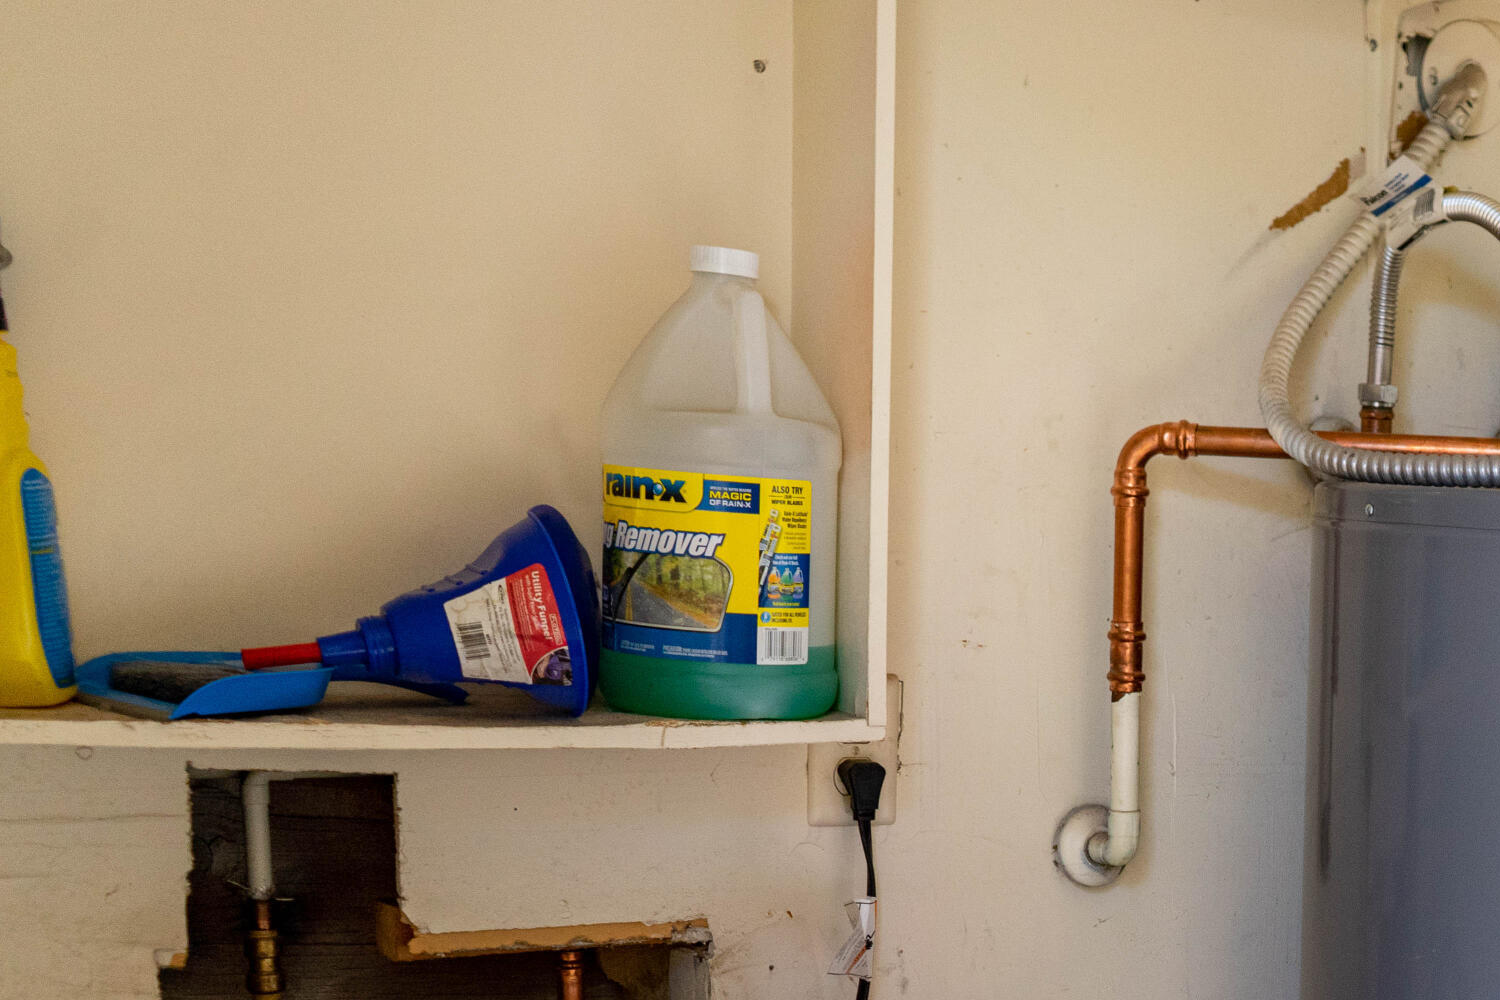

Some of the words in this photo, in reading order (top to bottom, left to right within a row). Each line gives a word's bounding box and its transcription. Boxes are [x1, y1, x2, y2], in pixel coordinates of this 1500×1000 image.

[709, 490, 752, 502] MAGIC
[772, 485, 790, 494] ALSO
[791, 486, 804, 495] TRY
[722, 499, 752, 509] RAIN-X
[615, 520, 725, 558] Remover
[531, 570, 543, 603] Utility
[537, 605, 553, 640] Funnel
